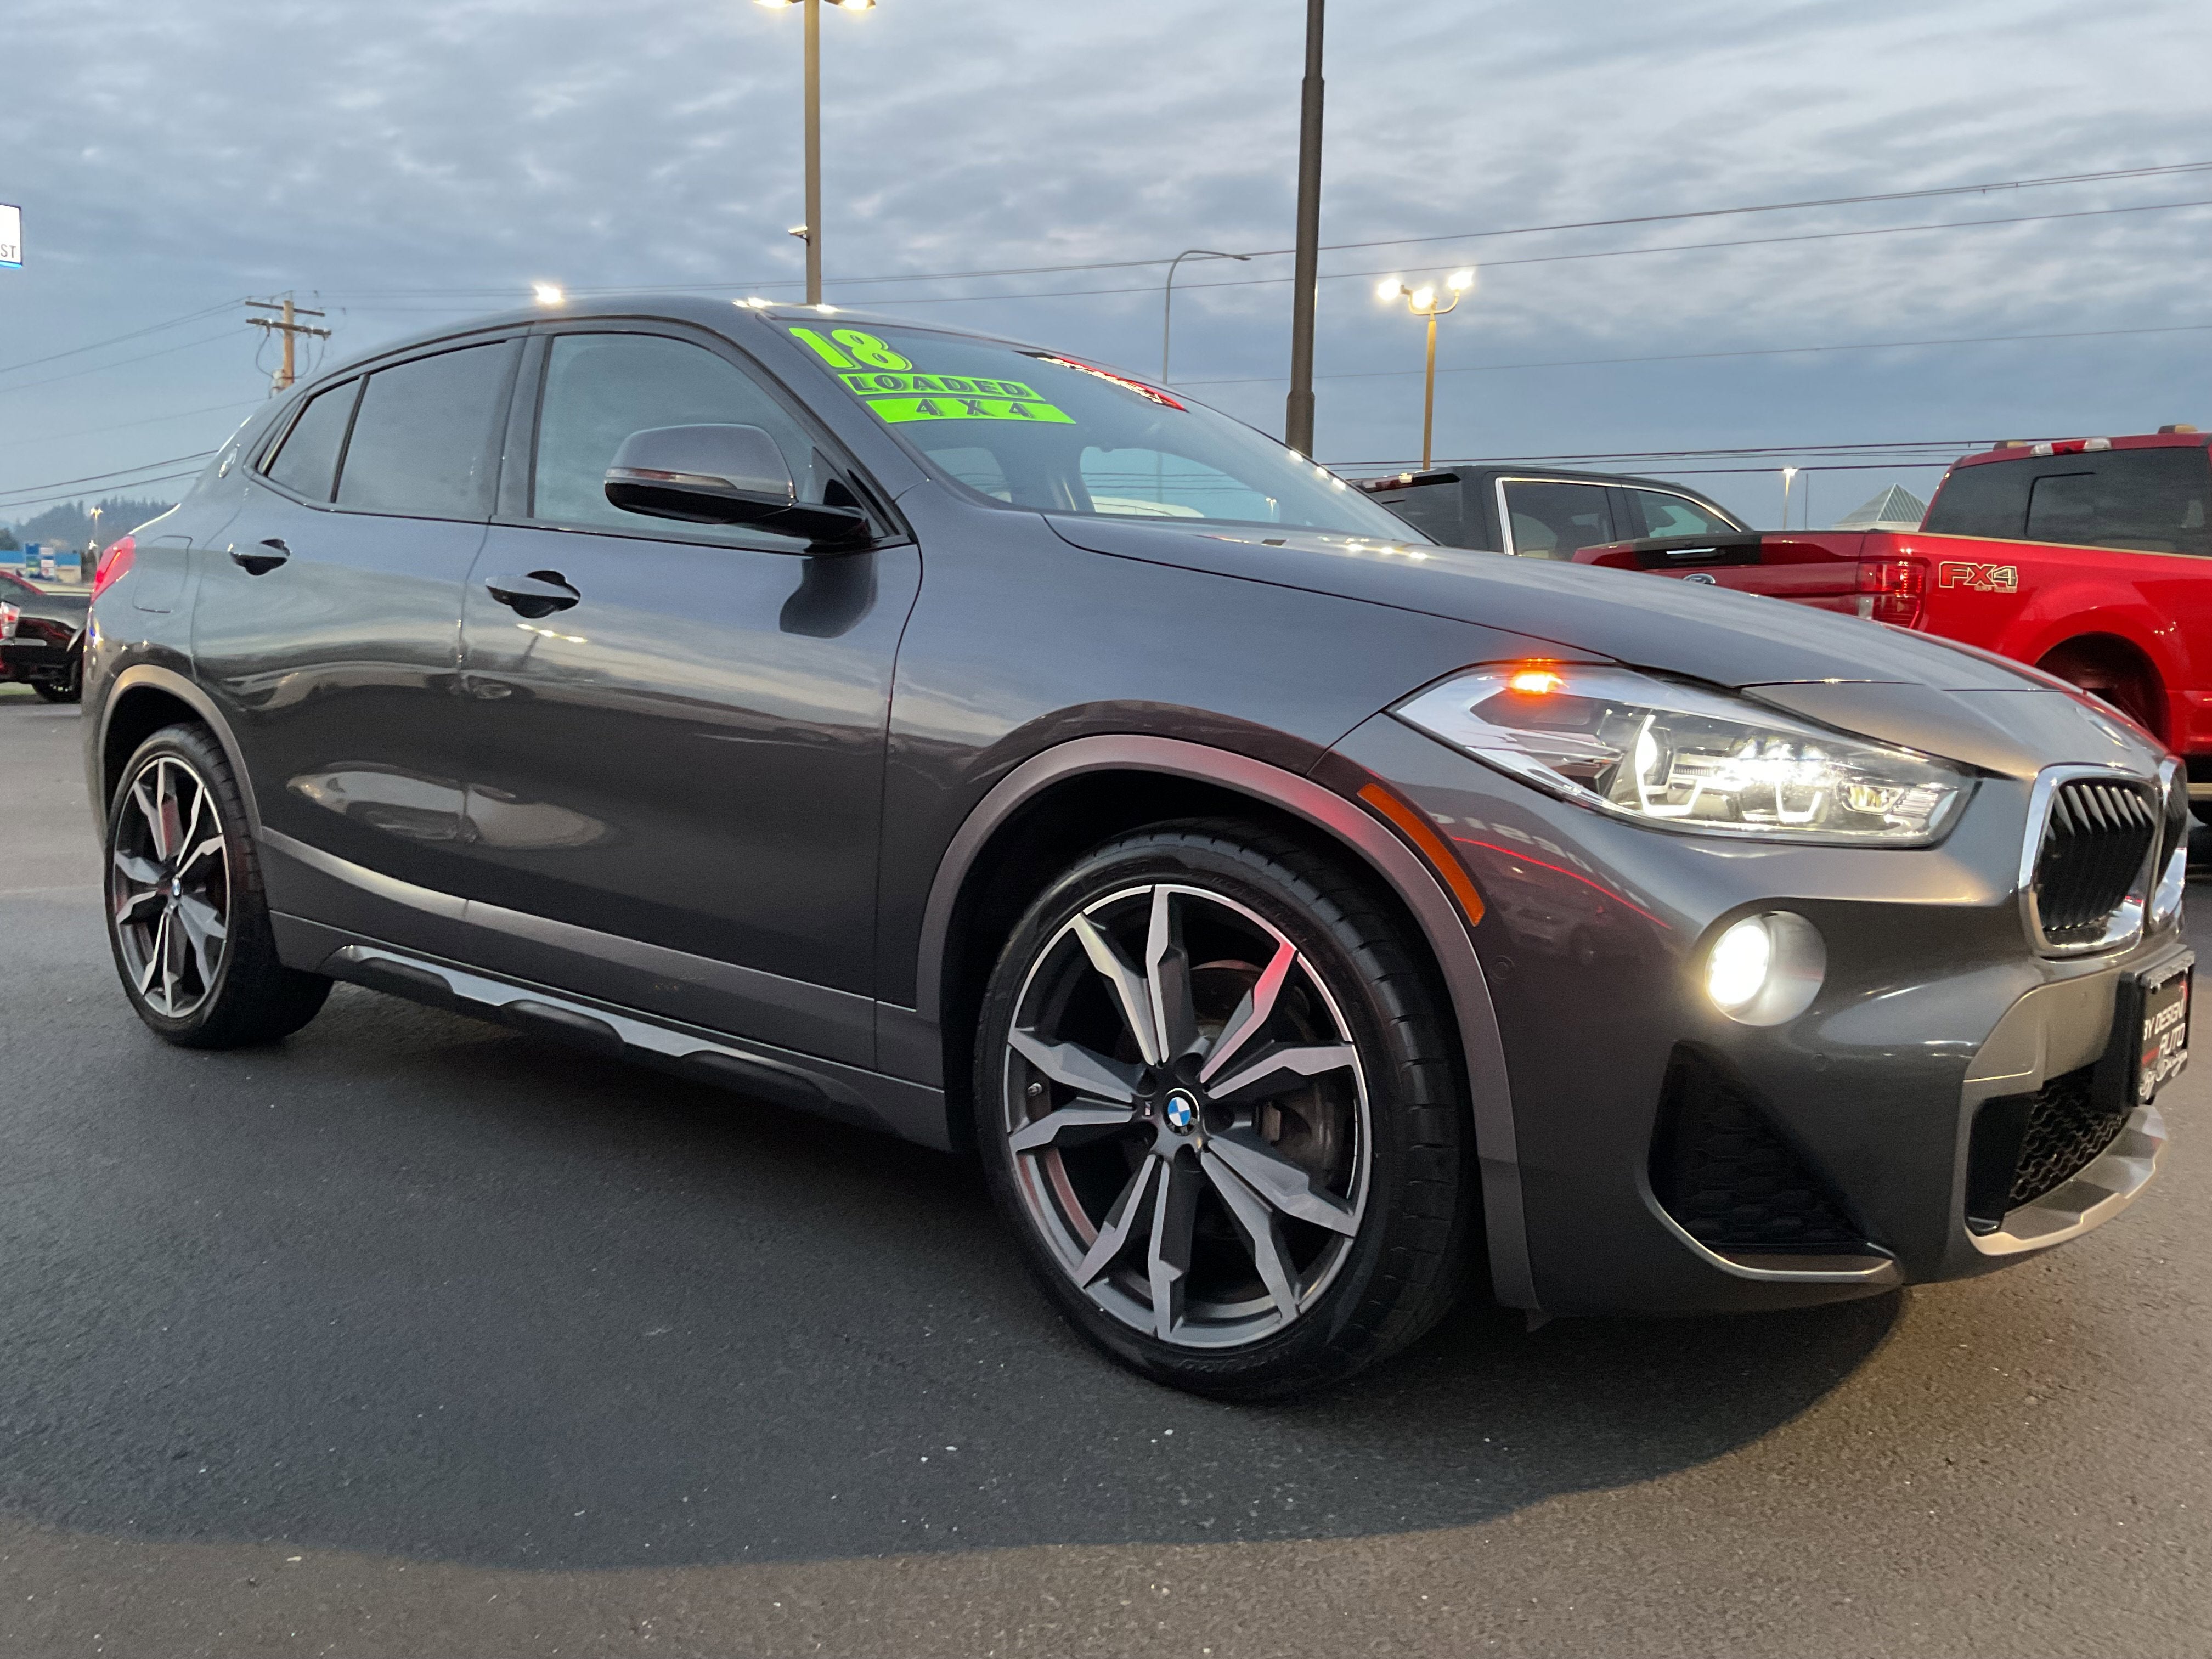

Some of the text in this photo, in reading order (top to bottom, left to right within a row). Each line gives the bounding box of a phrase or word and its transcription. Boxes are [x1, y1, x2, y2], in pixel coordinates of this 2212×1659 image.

[789, 328, 912, 371] 18
[847, 375, 1031, 397] LOADED
[1939, 561, 2018, 588] FX4
[2159, 1022, 2186, 1059] AUTO
